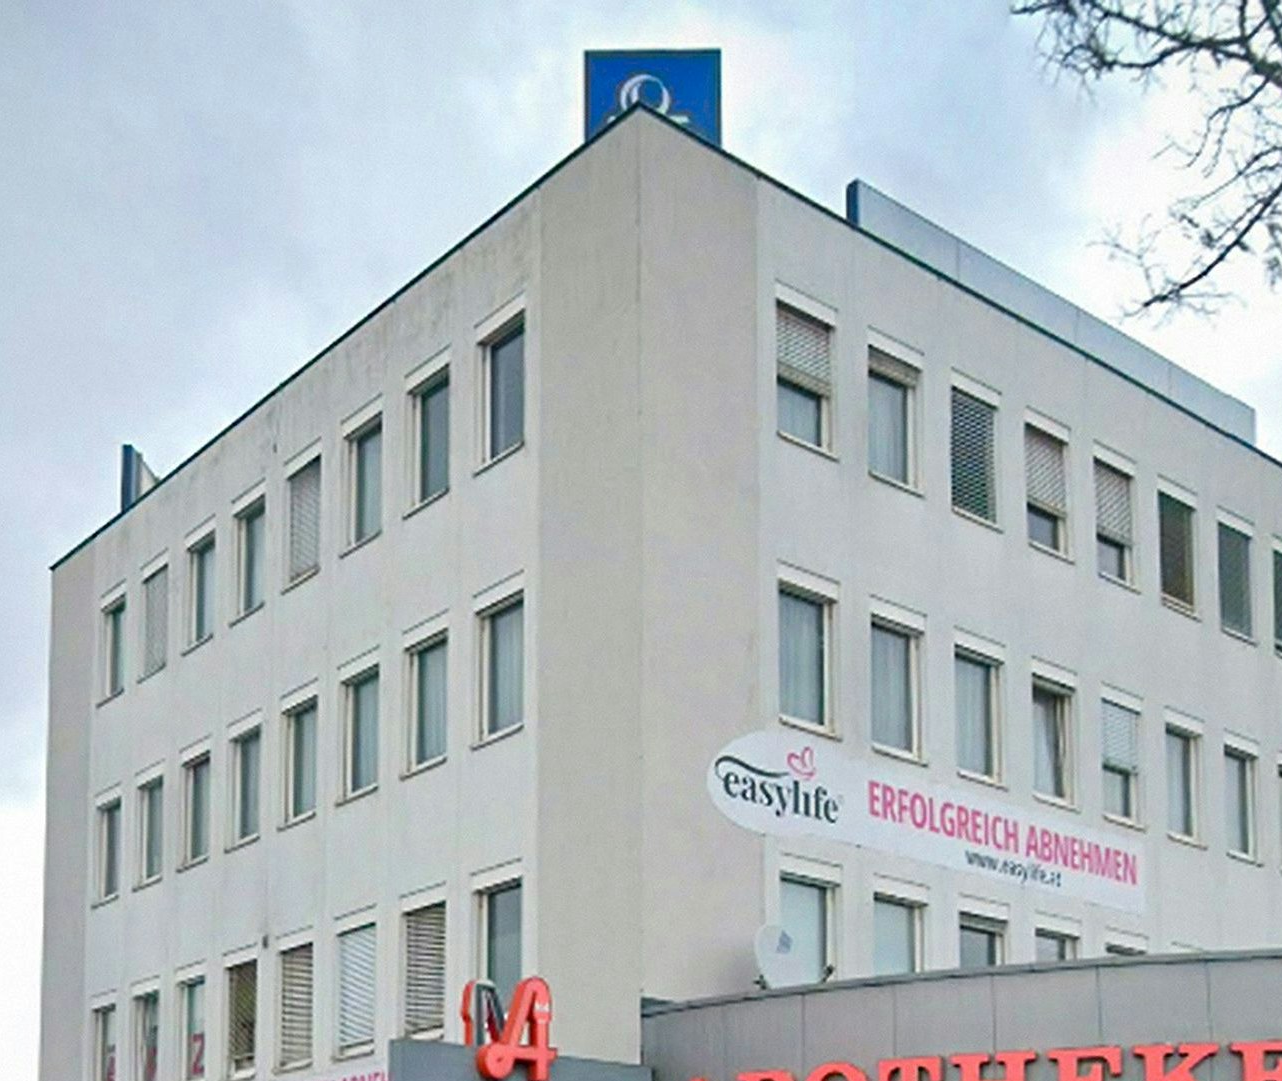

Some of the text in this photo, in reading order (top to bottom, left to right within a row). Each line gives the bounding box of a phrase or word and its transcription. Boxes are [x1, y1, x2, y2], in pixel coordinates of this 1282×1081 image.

[716, 758, 839, 823] easylife
[867, 779, 1138, 886] ERFOLGREICH ABNEHMEN
[964, 850, 1063, 888] www.easylife.at
